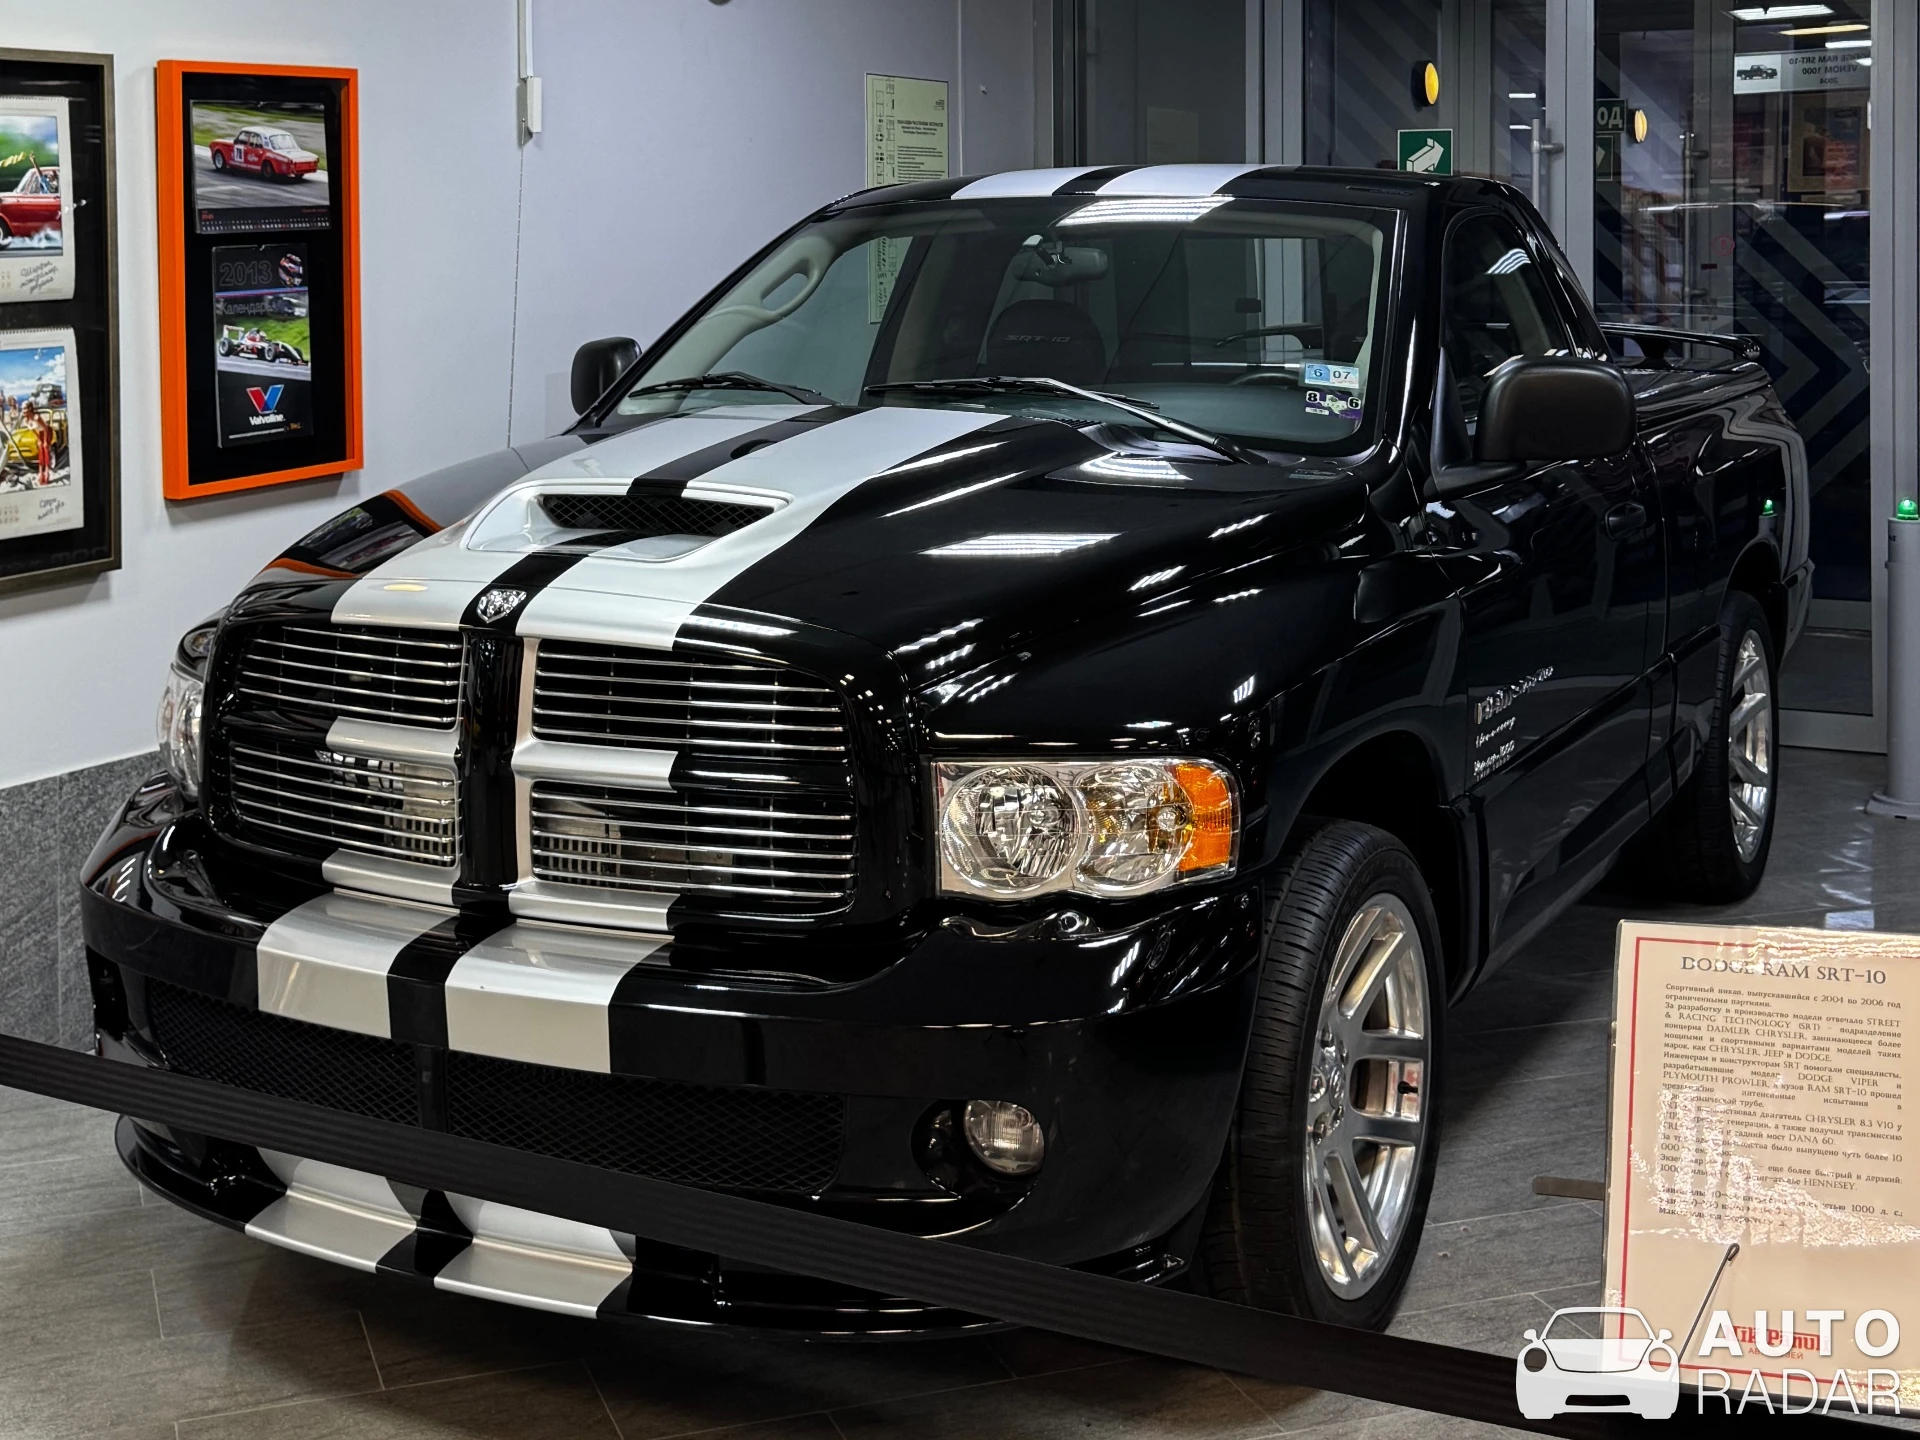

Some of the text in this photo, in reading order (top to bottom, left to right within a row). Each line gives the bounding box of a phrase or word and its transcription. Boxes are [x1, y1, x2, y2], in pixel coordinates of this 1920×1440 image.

[220, 260, 272, 286] 2013
[1004, 334, 1072, 343] SRT-10
[1314, 368, 1351, 380] 6 07
[1307, 392, 1318, 403] 8
[1348, 397, 1360, 409] 6
[249, 414, 285, 426] Valvoline
[1681, 957, 1886, 984] DODGE RAM SRT-10
[1665, 994, 1728, 1004] ограниченными
[1666, 983, 1714, 993] Спортивный
[1748, 990, 1809, 1001] выпускавшийся
[1821, 995, 1843, 1003] 2004
[1861, 998, 1883, 1006] 2006
[1678, 1003, 1721, 1014] разработку
[1735, 1009, 1789, 1018] производство
[1826, 1016, 1863, 1024] отвечало
[1867, 1018, 1901, 1027] STREET
[1679, 1013, 1716, 1022] RACING
[1723, 1016, 1791, 1028] TECHNOLOGY
[1799, 1022, 1820, 1031] (SRT)
[1840, 1027, 1901, 1038] подразделение
[1665, 1022, 1901, 1048] концерна DAIMLER CHRYSLER, занимающееся более
[1664, 1033, 1703, 1041] мощными
[1721, 1037, 1776, 1047] спортивными
[1782, 1042, 1830, 1052] вариантами
[1837, 1047, 1871, 1056] моделей
[1709, 1045, 1760, 1056] CHRYSLER,
[1664, 1052, 1708, 1062] Инженерам
[1720, 1058, 1780, 1068] конструкторам
[1784, 1061, 1800, 1070] SRT
[1804, 1065, 1842, 1073] помогали
[1663, 1062, 1734, 1074] разрабатывавшие
[1798, 1073, 1833, 1083] DODGE
[1851, 1077, 1878, 1087] VIPER
[1663, 1071, 1718, 1083] PLYMOUTH
[1722, 1077, 1770, 1088] PROWLER,
[1808, 1084, 1830, 1093] RAM
[1834, 1086, 1866, 1096] SRT-10
[1870, 1092, 1901, 1100] прошел
[1662, 1082, 1715, 1093] чрезайно
[1824, 1098, 1868, 1107] испытания
[1740, 1100, 1764, 1108] трубе.
[1760, 1110, 1802, 1121] двигатель
[1806, 1114, 1856, 1126] CHRYSLER
[1877, 1120, 1894, 1129] V10
[1897, 1124, 1902, 1132] у
[1767, 1133, 1785, 1141] мост
[1789, 1134, 1818, 1144] DANA
[1782, 1124, 1806, 1132] также
[1810, 1127, 1843, 1136] получил
[1847, 1130, 1902, 1140] трансмиссию
[1796, 1147, 1839, 1156] выпущено
[1865, 1153, 1889, 1161] более
[1892, 1154, 1902, 1162] 10
[1788, 1167, 1811, 1175] более
[1804, 1178, 1857, 1191] HENNESEY.
[1852, 1204, 1875, 1214] 1000
